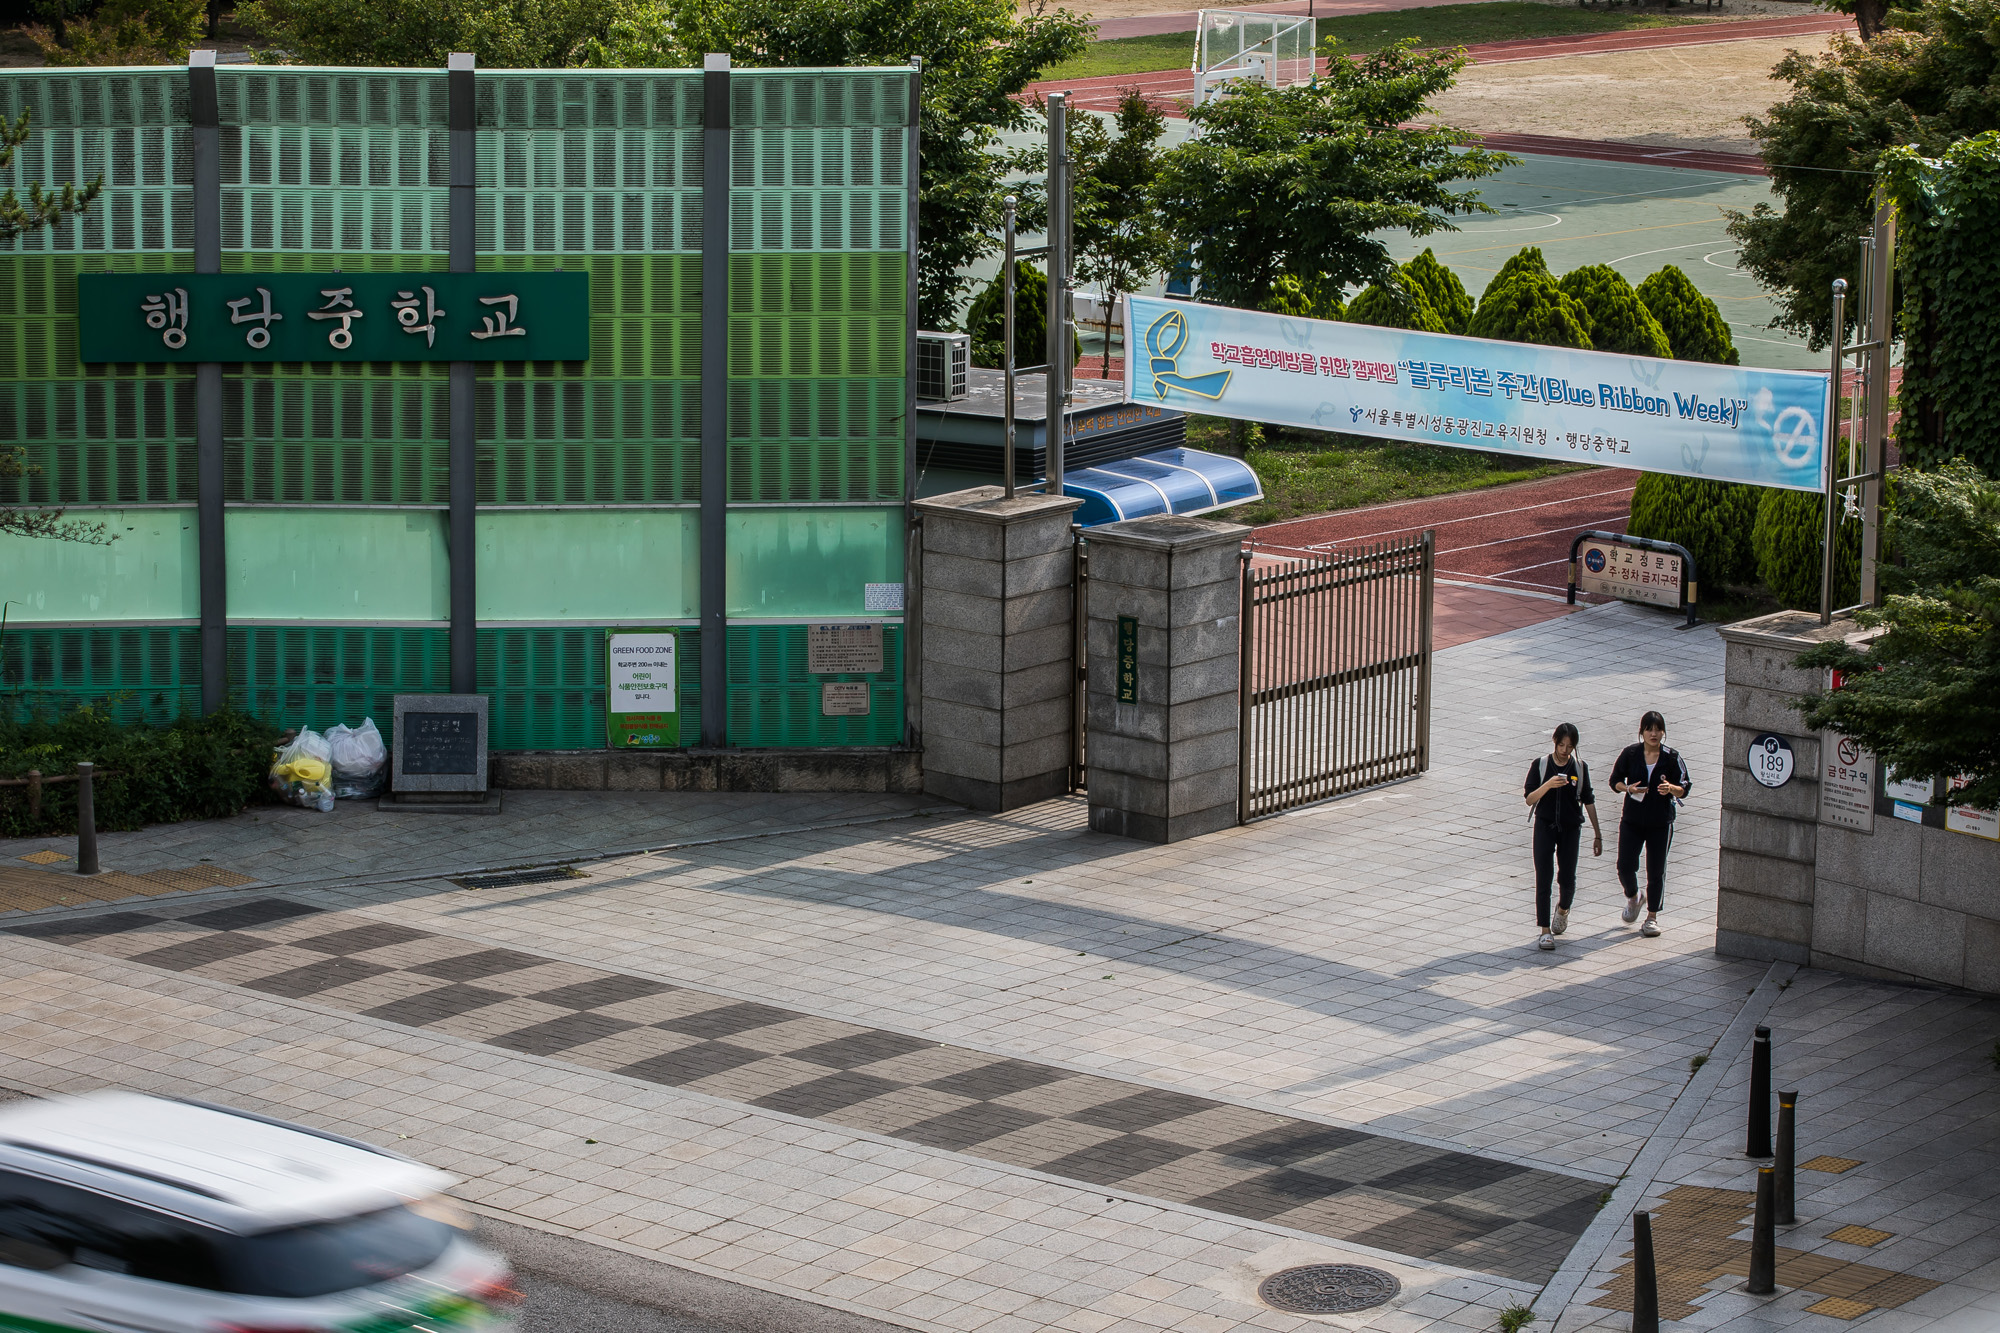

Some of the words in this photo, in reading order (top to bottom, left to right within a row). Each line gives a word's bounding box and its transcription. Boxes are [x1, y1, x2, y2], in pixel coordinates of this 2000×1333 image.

[140, 287, 527, 350] 행당중학교
[1210, 341, 1316, 374] 학교흡연예방을
[1319, 355, 1349, 377] 위한
[1352, 359, 1397, 384] 캠페인
[1598, 383, 1670, 417] Ribbon
[1365, 407, 1548, 446] 서울특별시성동광진교육지원청
[1566, 431, 1631, 454] 행당중학교
[612, 646, 635, 654] GREEN
[635, 646, 654, 654] FOOD
[655, 646, 673, 654] ZONE
[632, 672, 652, 680] 어린이
[618, 682, 668, 691] 식품안전보호구역
[1759, 753, 1784, 772] 189
[1828, 764, 1868, 785] 금연구역
